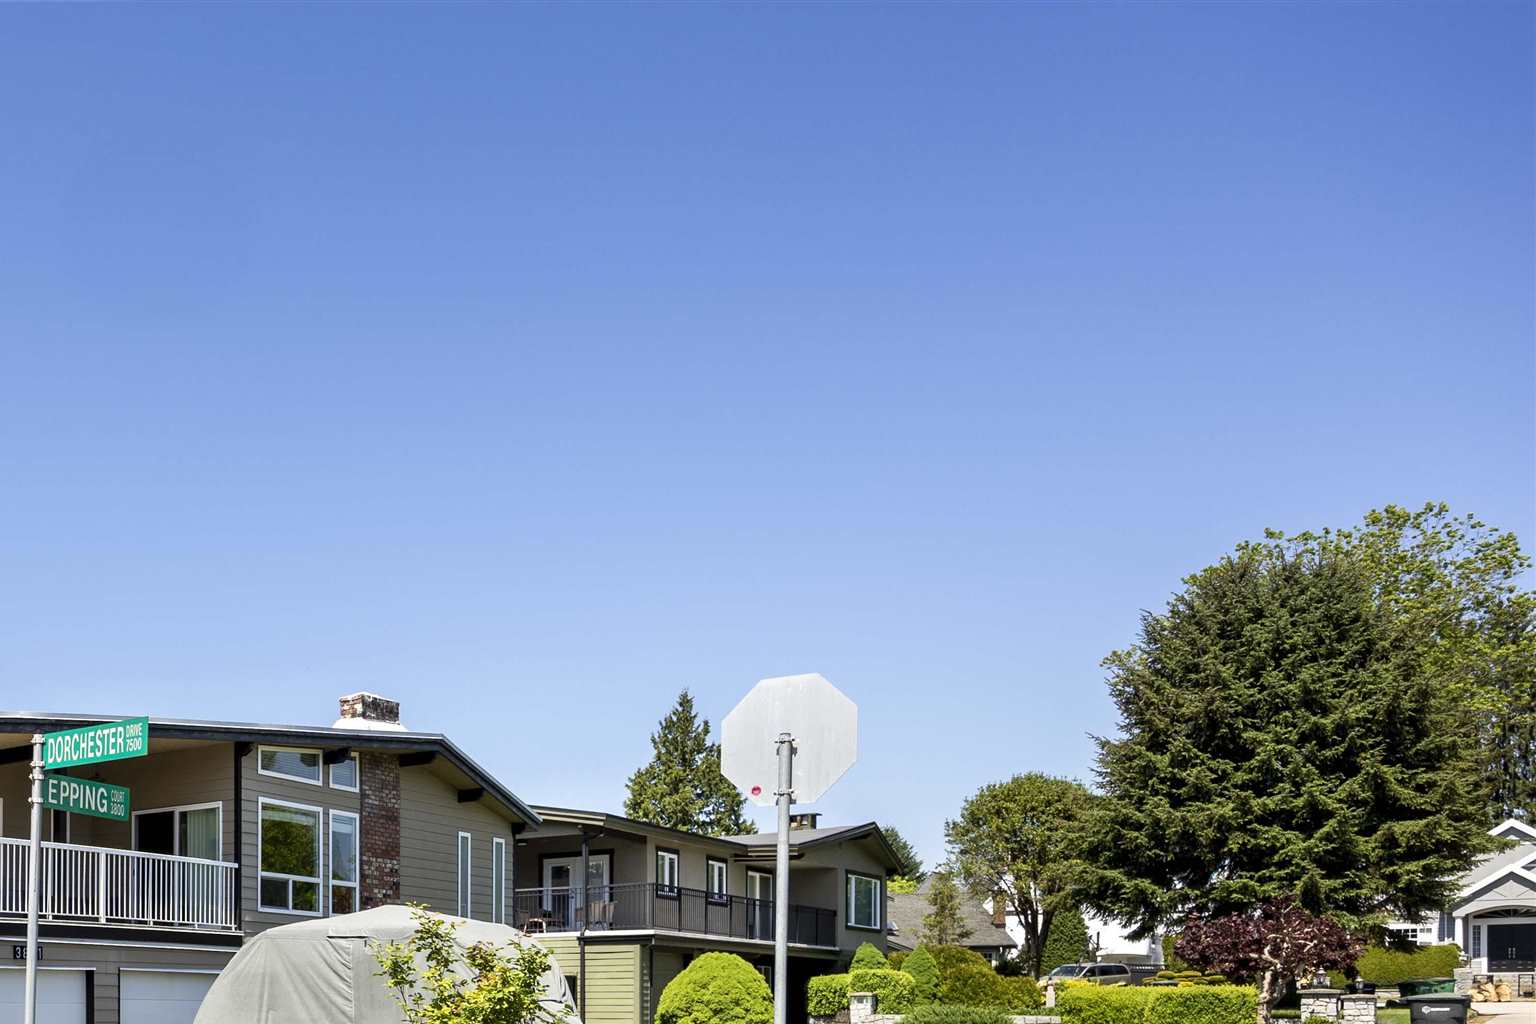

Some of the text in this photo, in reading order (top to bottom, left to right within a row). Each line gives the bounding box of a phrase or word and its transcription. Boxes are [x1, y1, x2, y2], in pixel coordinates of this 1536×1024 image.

[48, 723, 143, 763] DORCHESTER DRIVE
[126, 737, 142, 752] 7500
[48, 779, 108, 813] EPPING
[15, 946, 42, 959] 381
